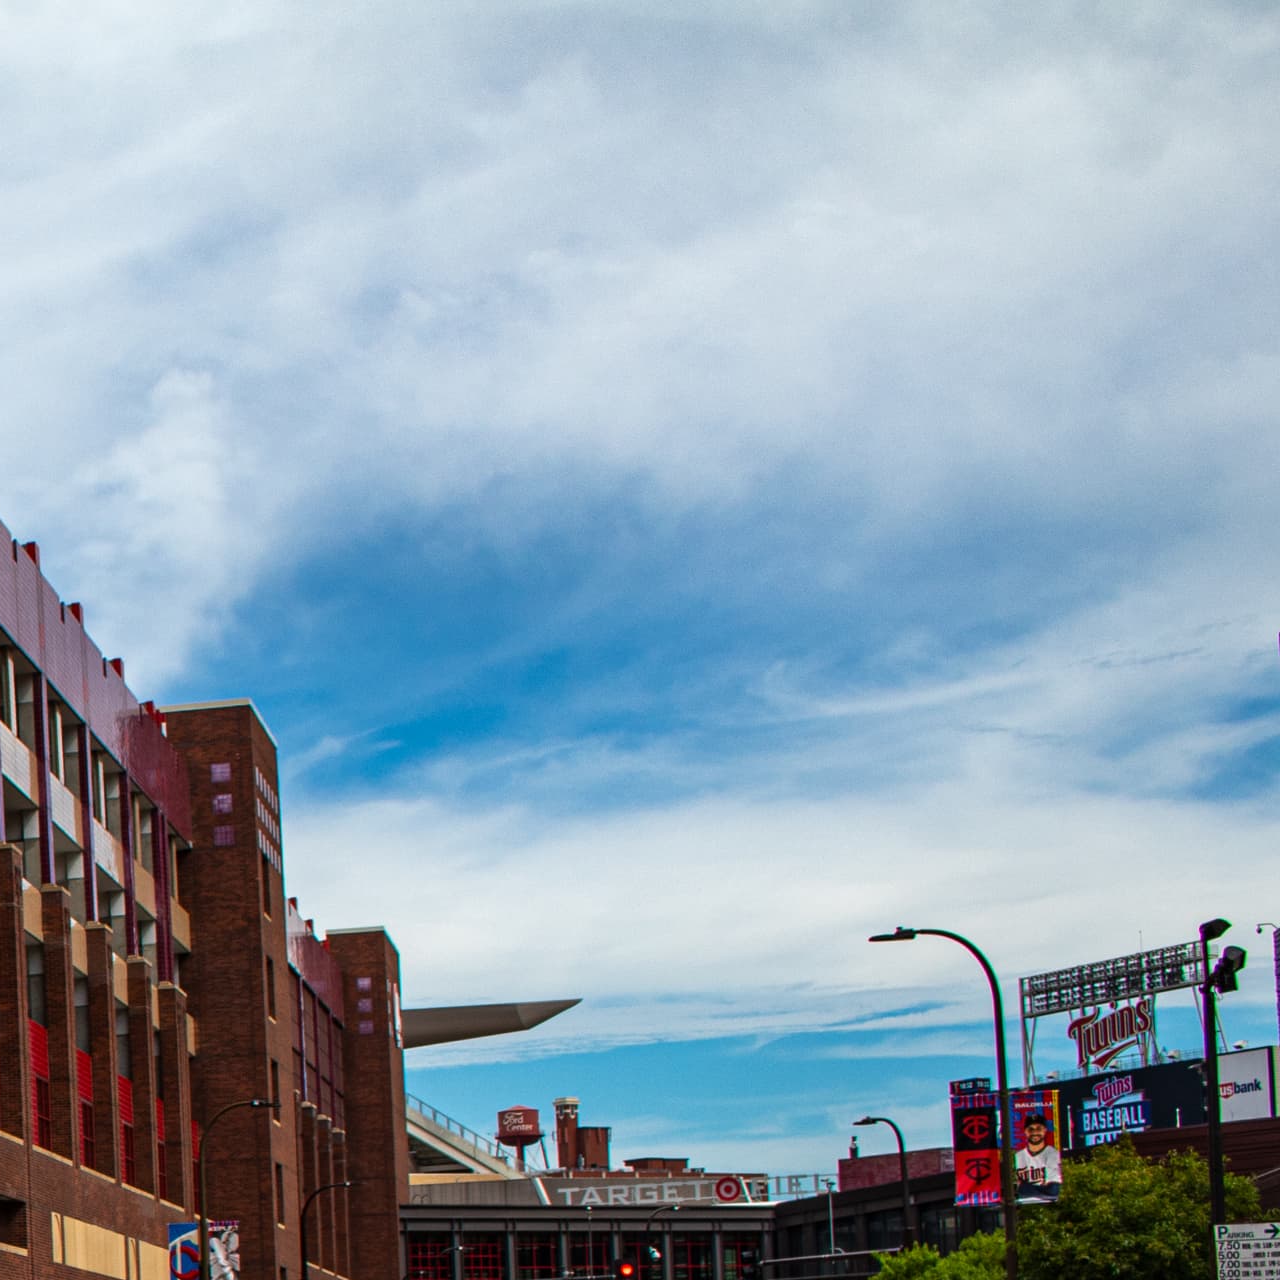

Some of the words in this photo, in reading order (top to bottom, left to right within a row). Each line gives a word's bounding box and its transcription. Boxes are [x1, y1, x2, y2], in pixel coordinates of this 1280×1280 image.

[1067, 1000, 1151, 1068] Twins
[1093, 1074, 1134, 1108] Twins
[502, 1112, 524, 1125] Ford
[506, 1123, 534, 1132] Center
[1082, 1105, 1146, 1132] BASEBALL
[557, 1180, 711, 1206] TARGET
[1218, 1241, 1240, 1251] 7.50
